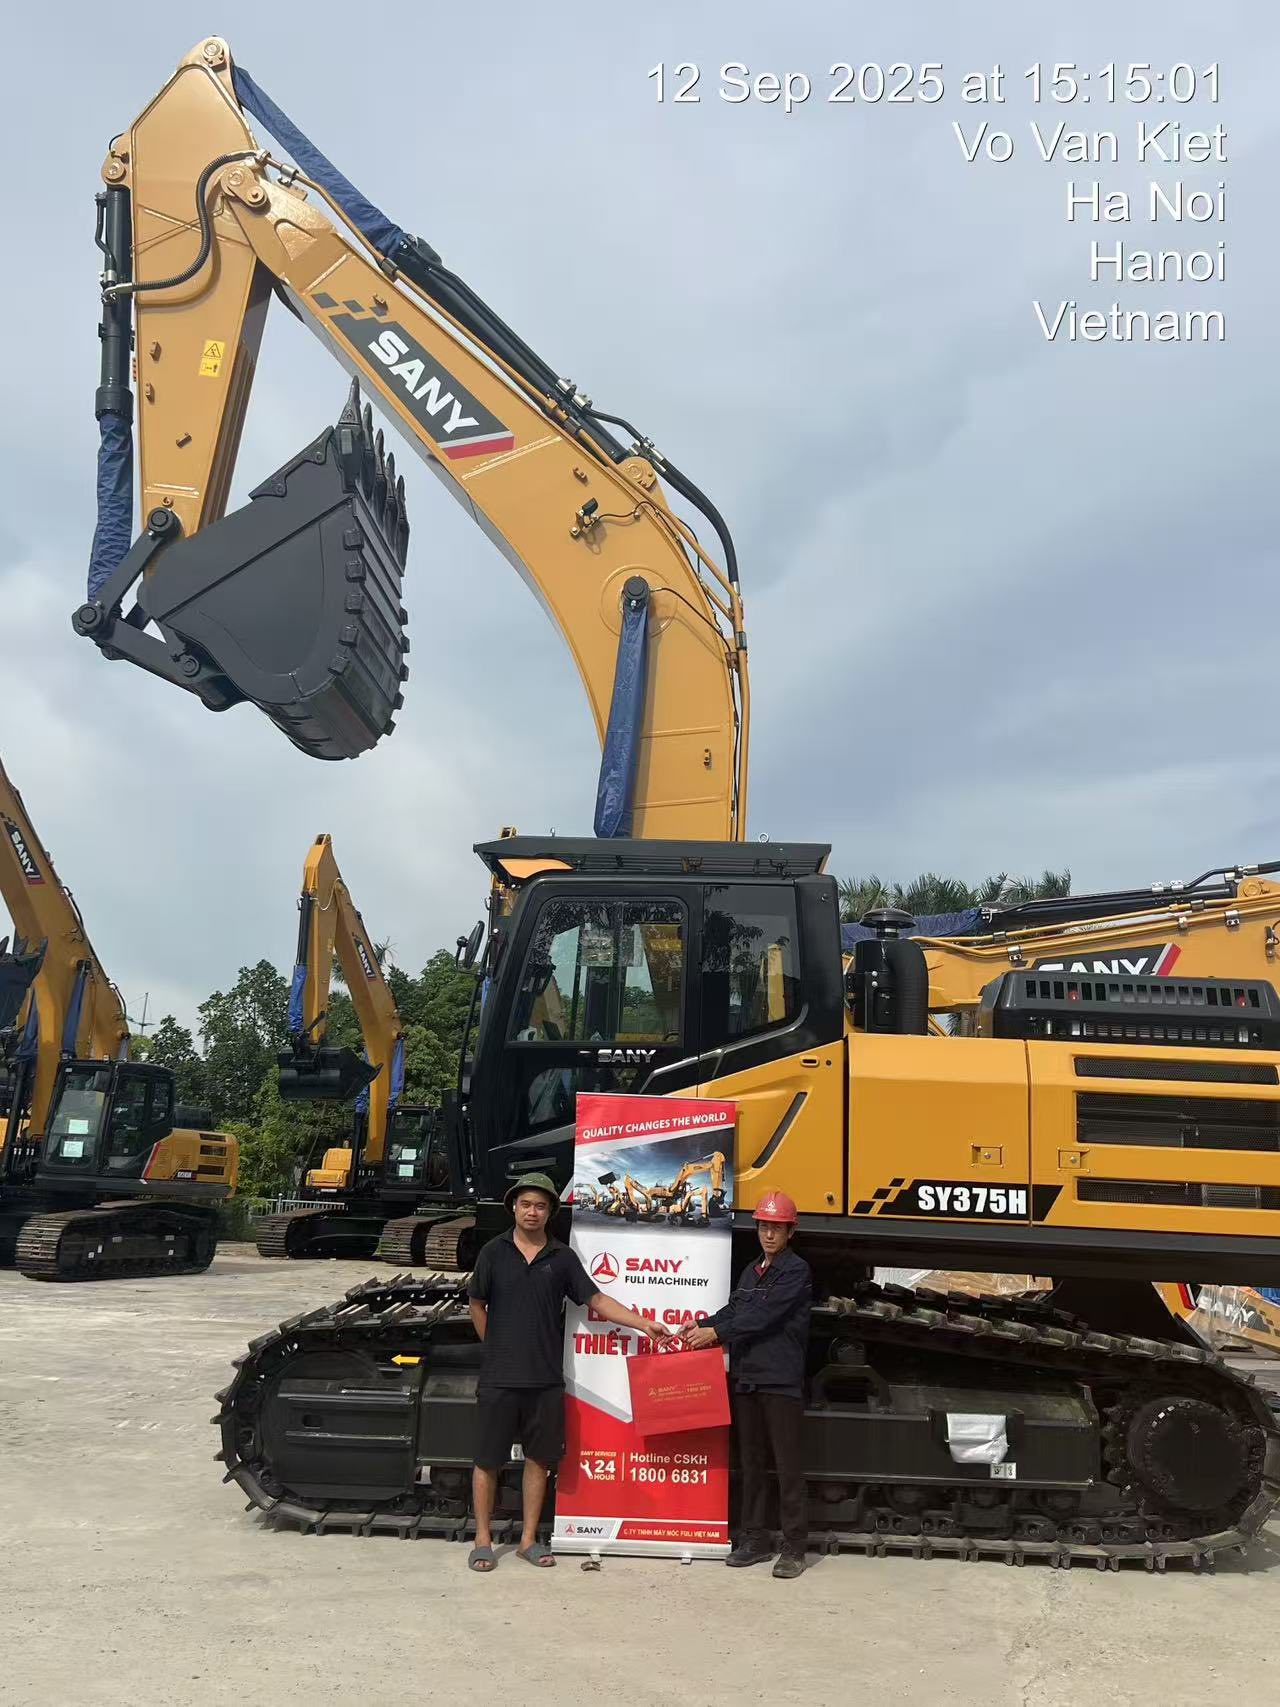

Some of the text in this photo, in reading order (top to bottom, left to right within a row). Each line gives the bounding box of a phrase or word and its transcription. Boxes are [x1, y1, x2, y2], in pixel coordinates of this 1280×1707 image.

[367, 330, 480, 434] SANY
[11, 831, 35, 873] SANY
[597, 1049, 657, 1063] SANY
[583, 1111, 727, 1139] QUALITY CHANGES THE WORLD
[918, 1185, 1027, 1215] SY375H
[625, 1257, 683, 1273] SANY
[625, 1275, 709, 1287] FULI MACHINERY
[573, 1327, 632, 1355] THIẾT
[594, 1459, 616, 1473] 24
[630, 1452, 708, 1465] Hotline CSKH
[629, 1467, 708, 1484] 1800 6831
[576, 1526, 603, 1534] SANY
